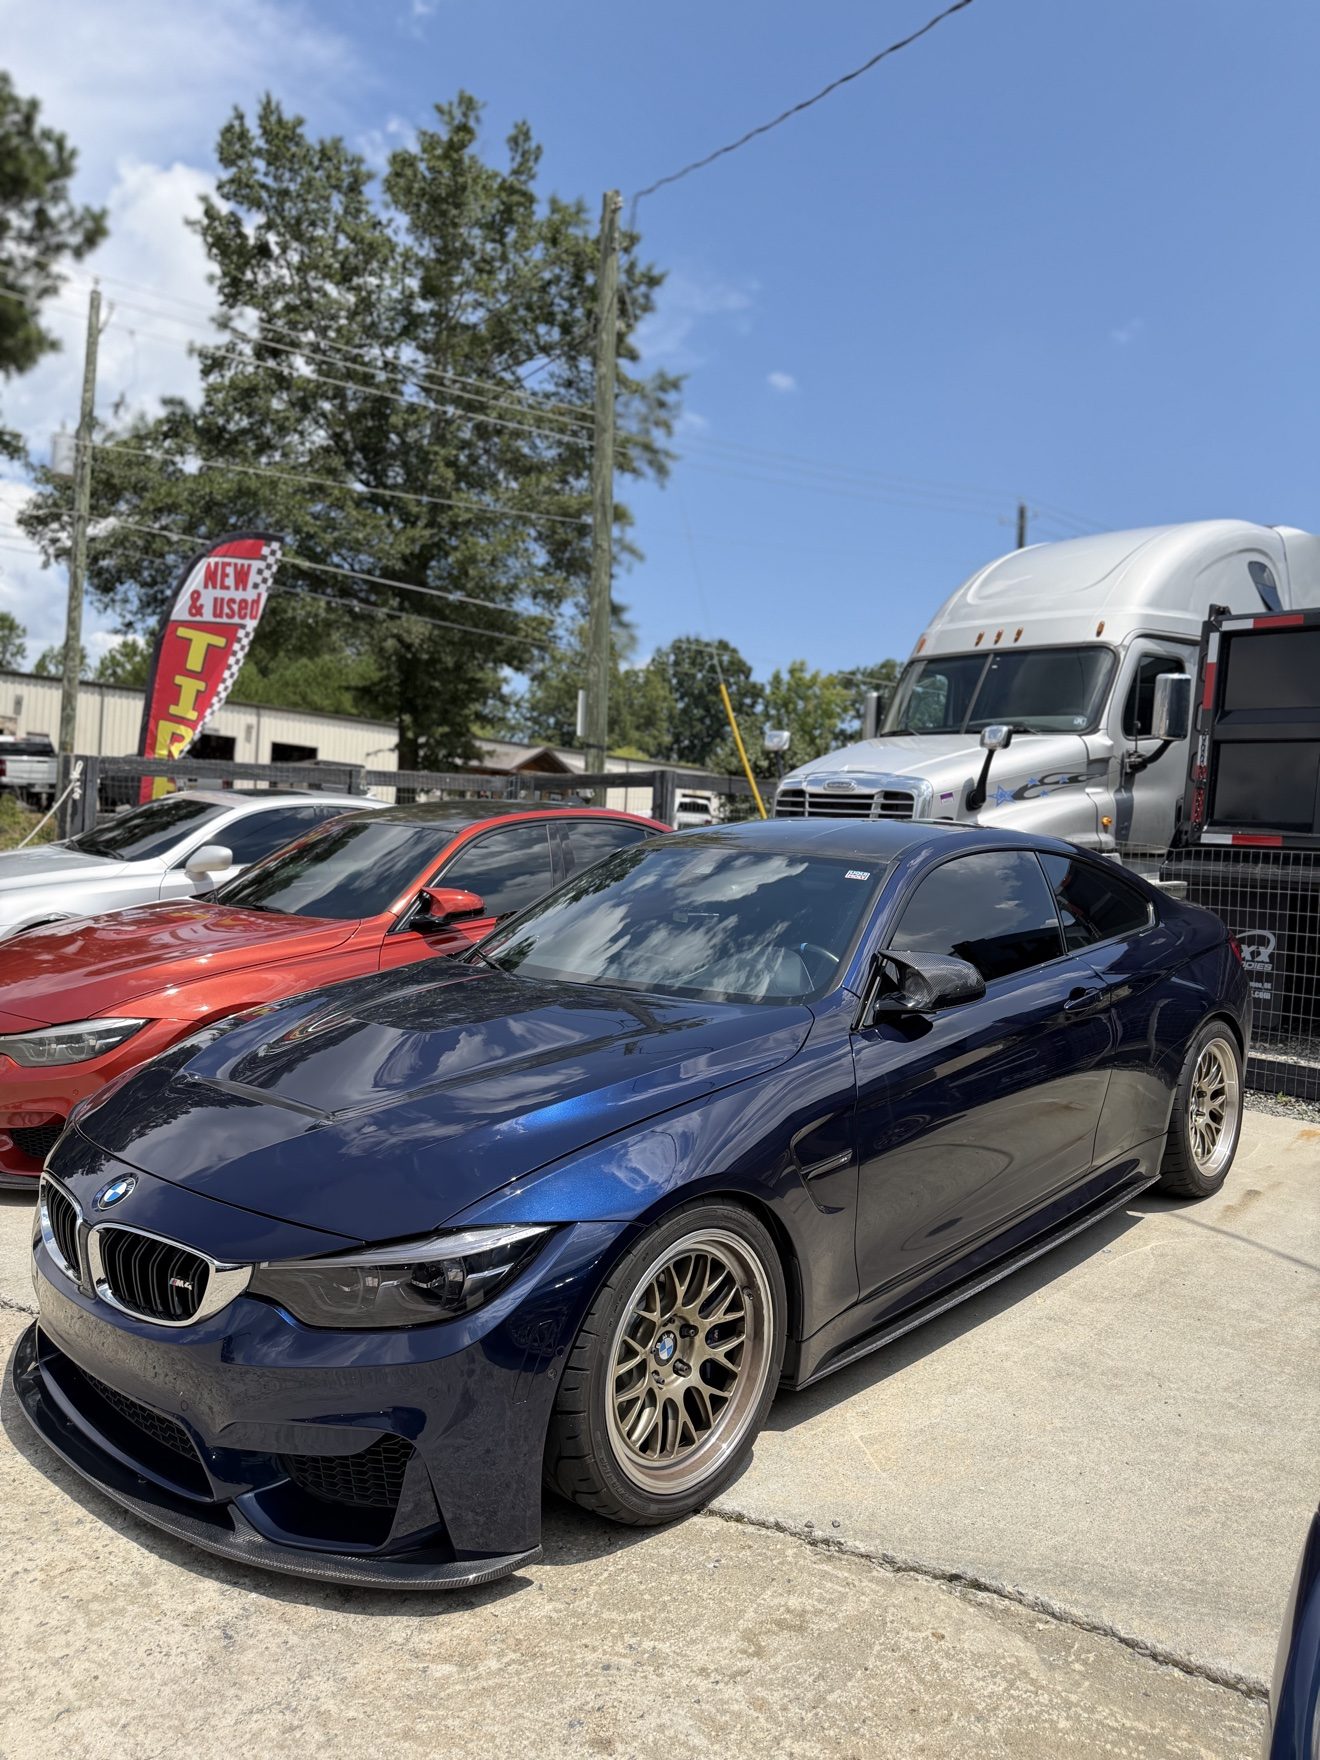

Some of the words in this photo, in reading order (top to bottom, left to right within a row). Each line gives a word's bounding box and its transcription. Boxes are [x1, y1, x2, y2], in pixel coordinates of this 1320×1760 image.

[203, 561, 253, 592] NEW
[188, 589, 204, 618] &
[212, 592, 262, 620] used
